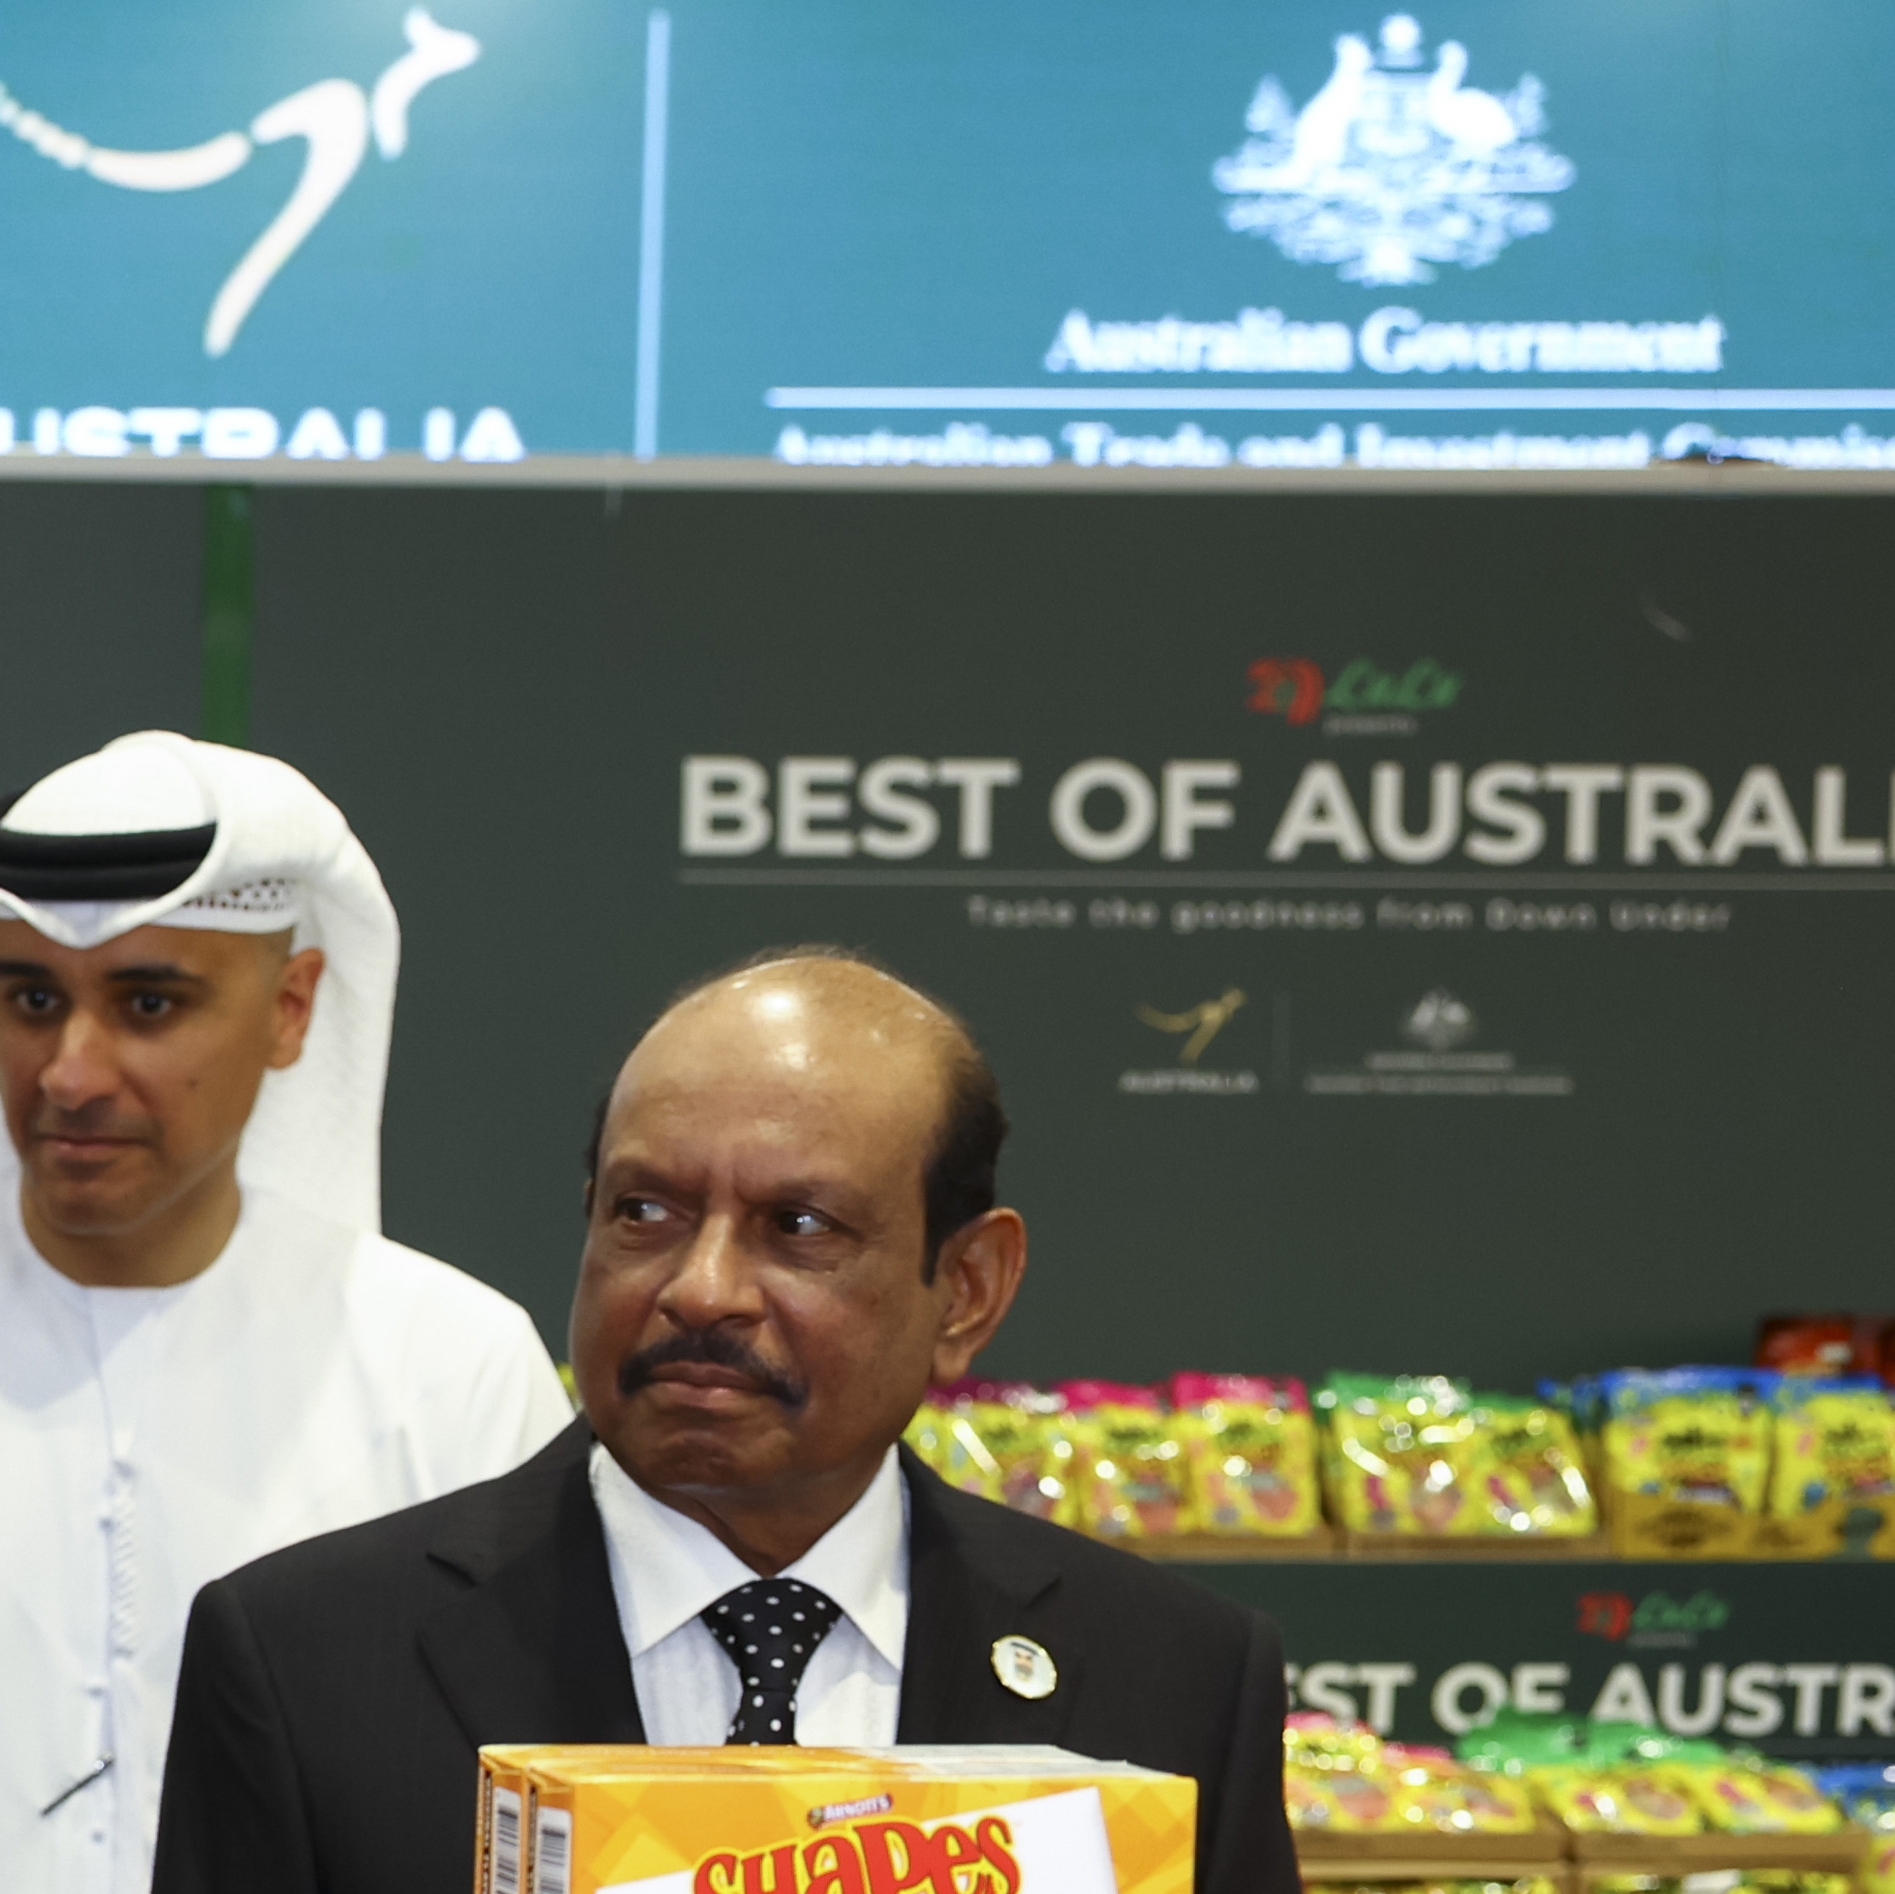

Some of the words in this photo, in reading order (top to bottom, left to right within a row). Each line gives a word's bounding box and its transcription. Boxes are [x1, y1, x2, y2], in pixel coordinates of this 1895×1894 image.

[1043, 306, 1353, 373] Australian
[1358, 304, 1725, 373] Government
[679, 757, 1021, 859] BEST
[1048, 758, 1240, 864] OF
[1265, 761, 1895, 868] AUSTRAL
[1089, 896, 1158, 930] the
[1170, 897, 1365, 934] goodness
[1376, 897, 1473, 931] from
[1485, 898, 1598, 932] Down
